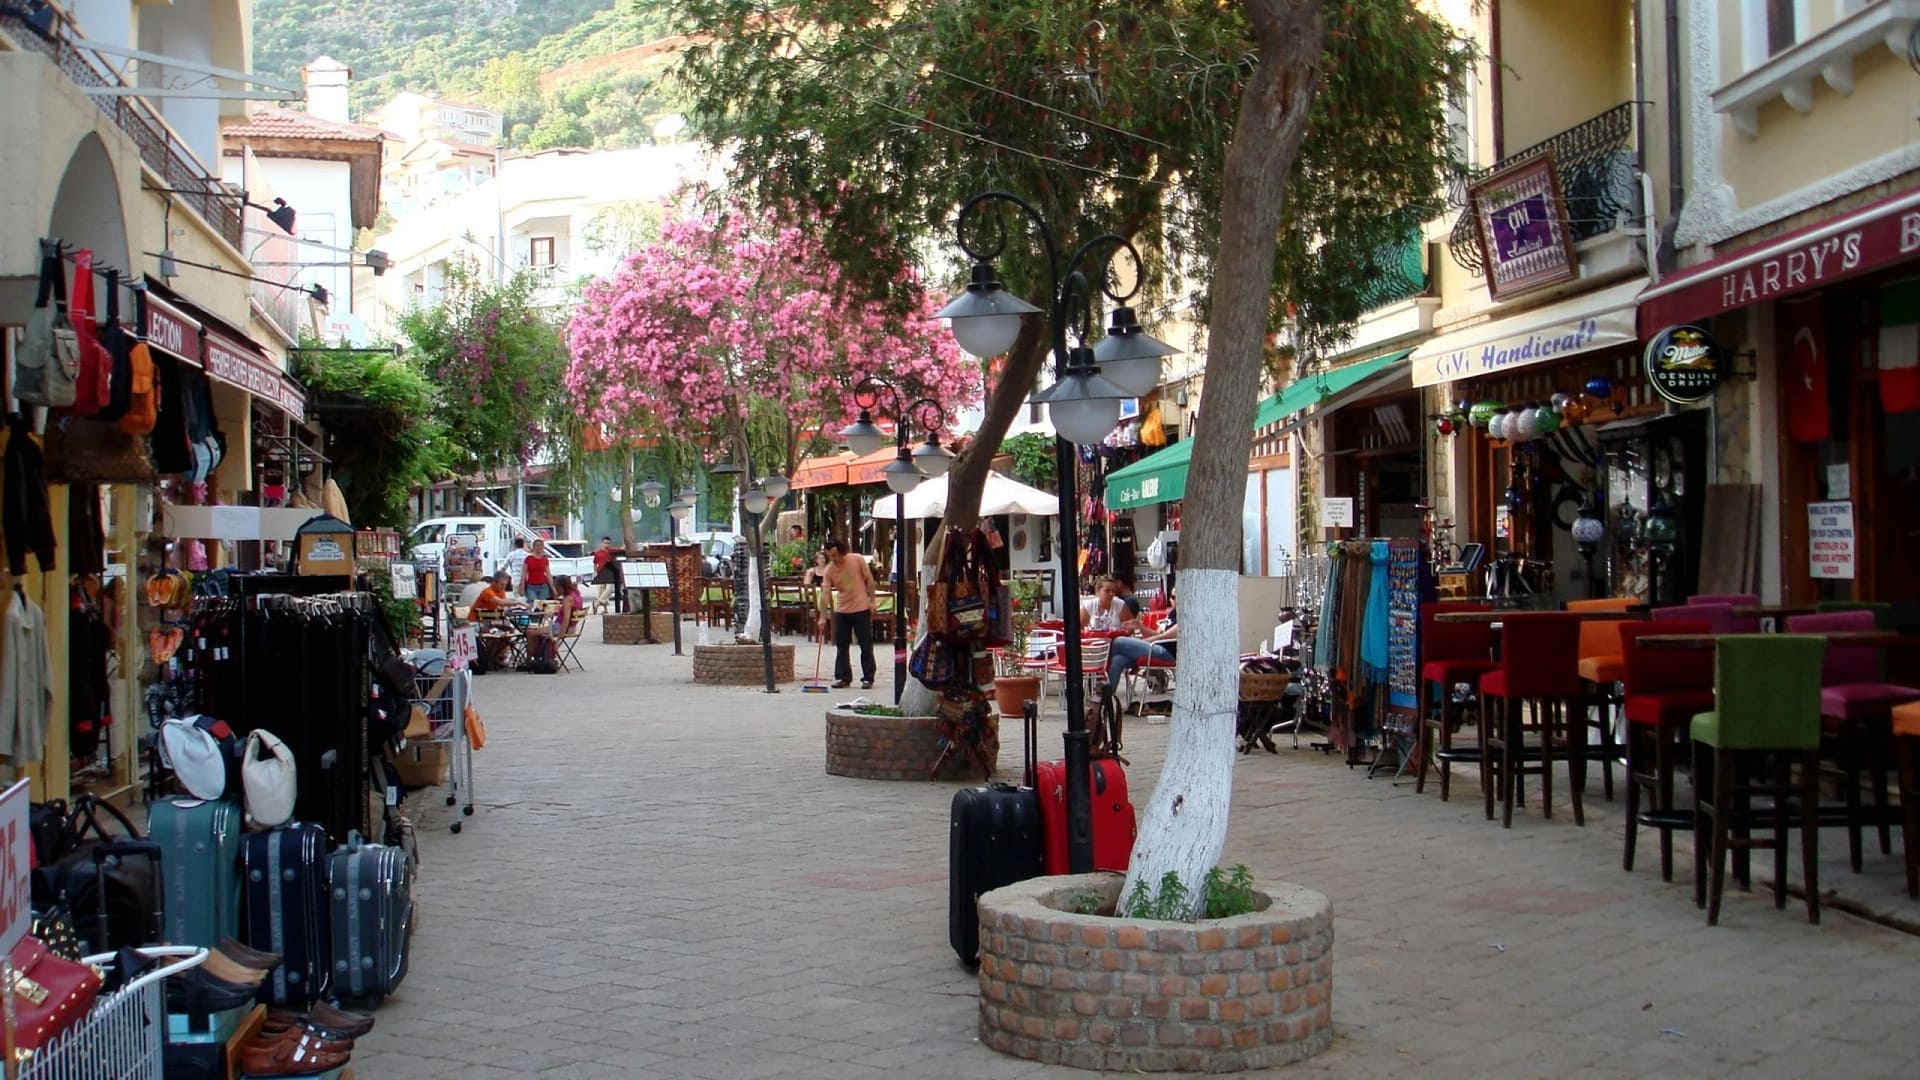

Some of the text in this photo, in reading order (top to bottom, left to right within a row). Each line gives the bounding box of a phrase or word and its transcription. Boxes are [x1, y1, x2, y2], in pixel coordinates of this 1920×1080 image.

[1723, 231, 1863, 307] HARRY'S
[1481, 319, 1597, 369] Handicraft
[1659, 372, 1717, 380] GENUINE
